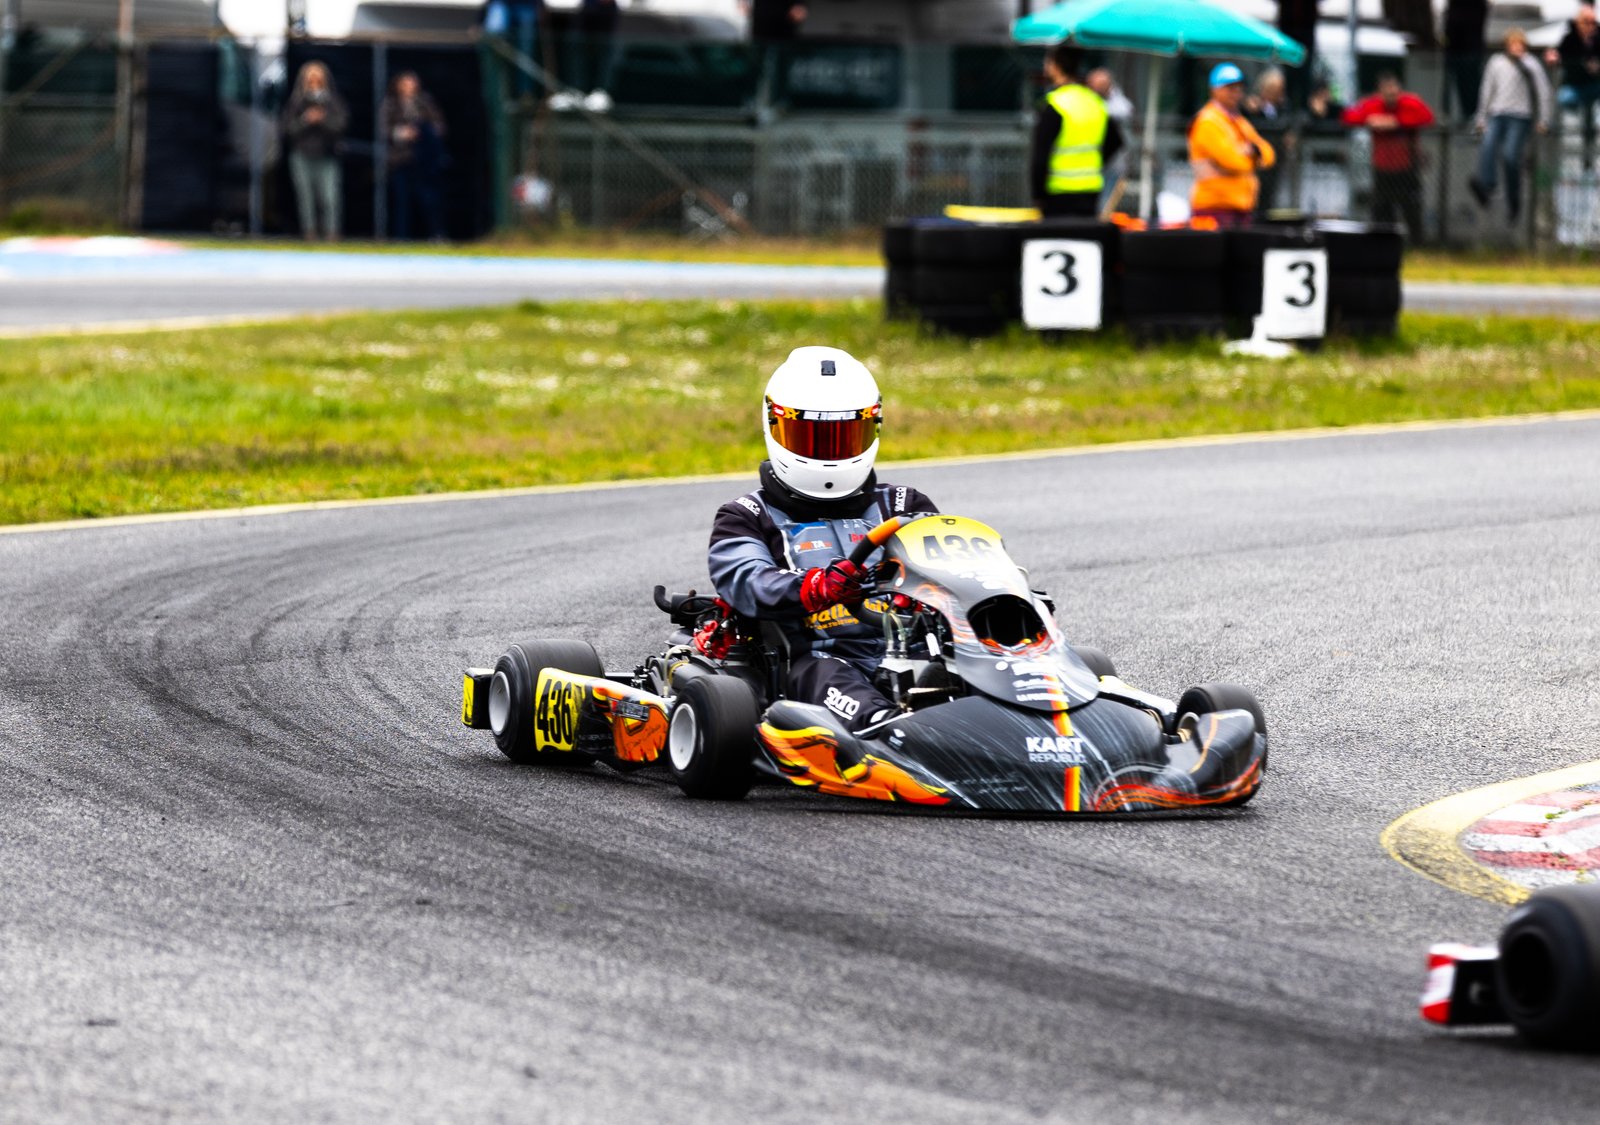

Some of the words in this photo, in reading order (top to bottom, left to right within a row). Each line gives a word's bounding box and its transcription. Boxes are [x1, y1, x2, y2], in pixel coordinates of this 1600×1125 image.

[1041, 250, 1079, 297] 3
[1285, 260, 1317, 307] 3
[922, 534, 998, 562] 436
[537, 679, 573, 745] 436
[1025, 736, 1082, 753] KART
[1028, 752, 1088, 764] REPUBLIC
